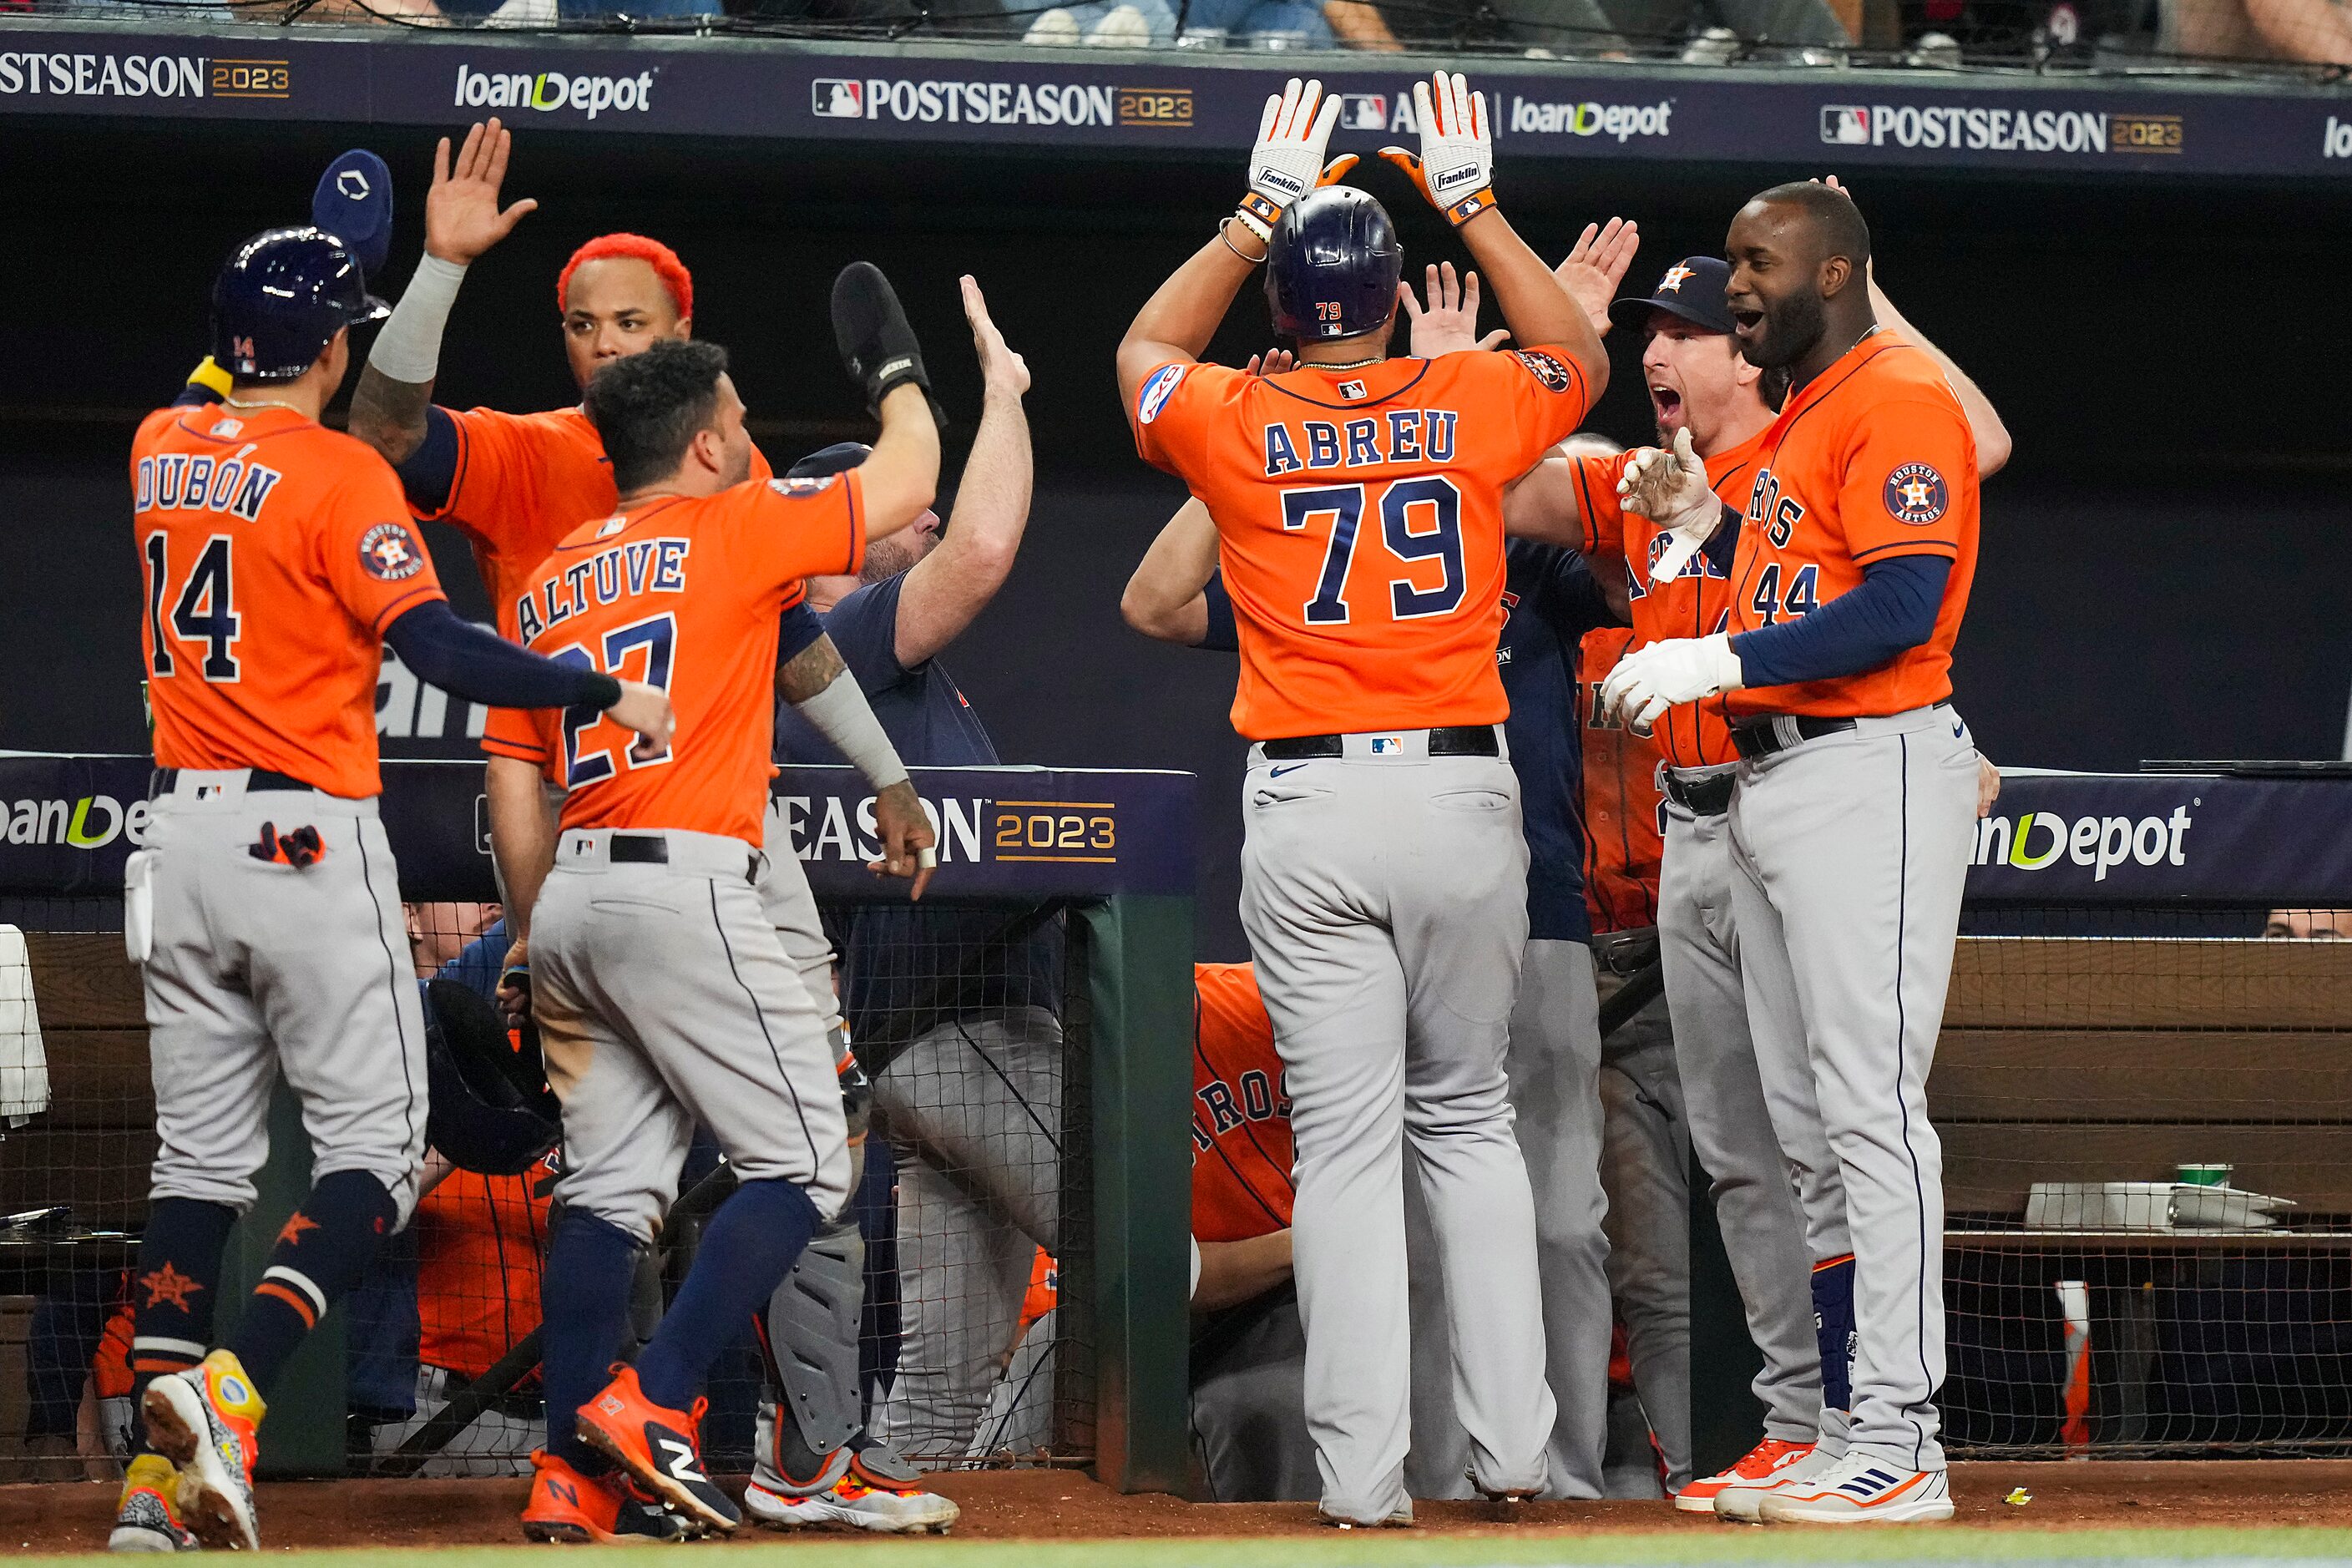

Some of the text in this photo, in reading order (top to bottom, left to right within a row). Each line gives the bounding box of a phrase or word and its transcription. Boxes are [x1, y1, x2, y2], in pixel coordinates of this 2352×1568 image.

[212, 68, 289, 89] 2023
[454, 64, 653, 120] loanDepot
[866, 80, 1193, 126] POSTSEASON 2023
[1510, 95, 1671, 143] loanDepot
[1872, 106, 2183, 153] POSTSEASON 2023
[1315, 301, 1342, 321] 79
[233, 336, 255, 358] 14
[1146, 366, 1181, 420] OXY
[1265, 409, 1459, 477] ABREU
[134, 443, 282, 523] DUBÓN
[1889, 465, 1940, 486] HOUSTON
[1746, 468, 1806, 550] ROS
[1895, 506, 1941, 523] ASTROS
[1280, 474, 1467, 625] 79
[145, 529, 241, 683] 14
[517, 537, 690, 649] ALTUVE
[1752, 562, 1821, 628] 44
[547, 610, 678, 792] 27
[995, 815, 1115, 848] 2023
